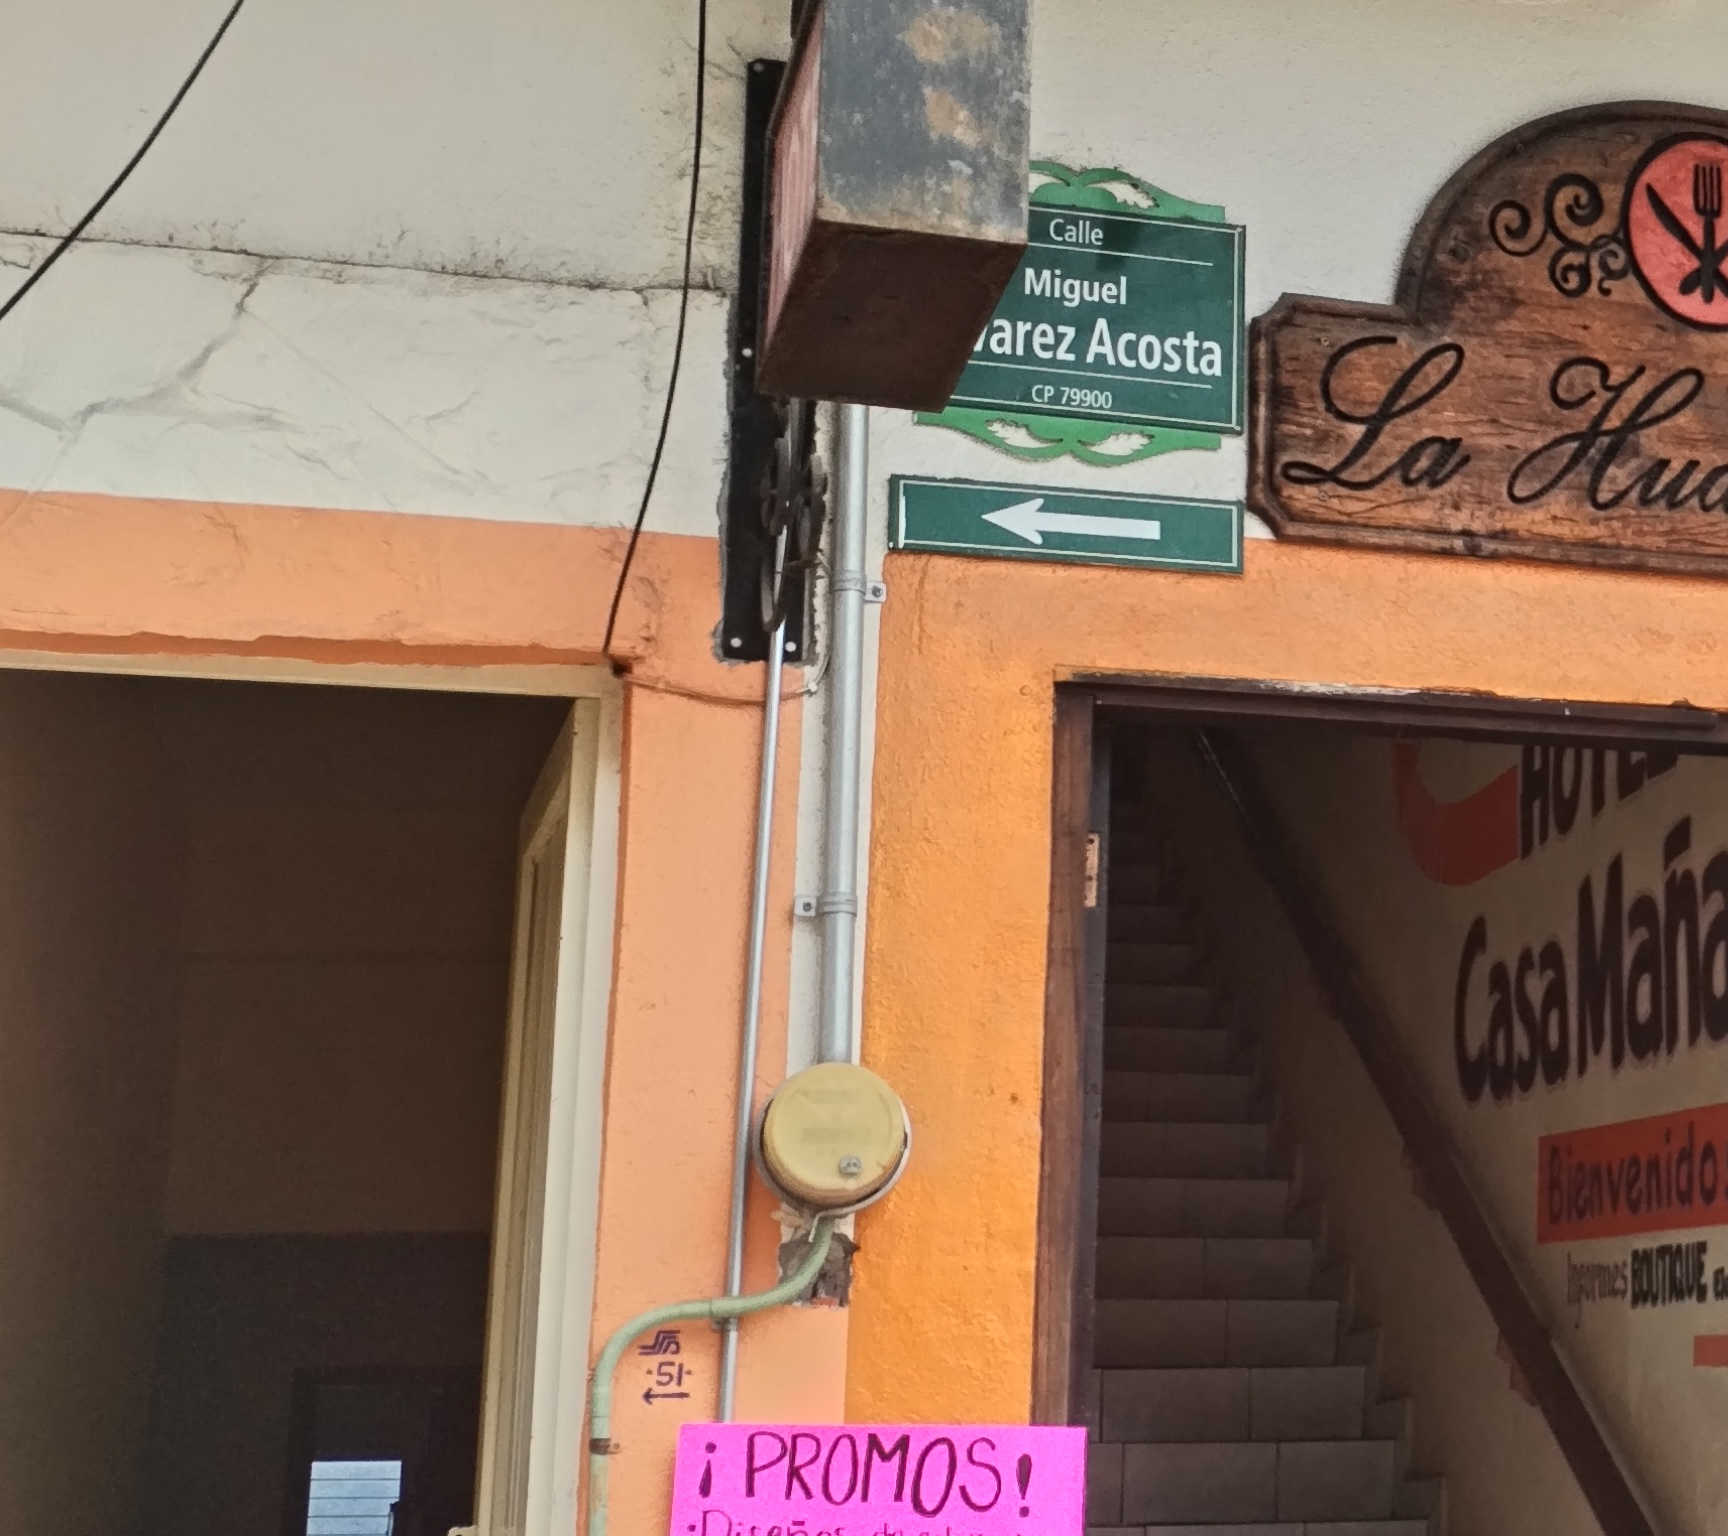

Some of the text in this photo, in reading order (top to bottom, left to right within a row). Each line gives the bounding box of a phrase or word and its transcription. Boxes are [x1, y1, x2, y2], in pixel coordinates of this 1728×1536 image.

[1048, 217, 1104, 246] Calle
[1023, 267, 1127, 308] Miguel
[1085, 317, 1222, 377] Acosta
[1031, 384, 1113, 410] CP 79900
[1281, 335, 1469, 491] La
[1631, 1240, 1707, 1309] BOUTIQUE
